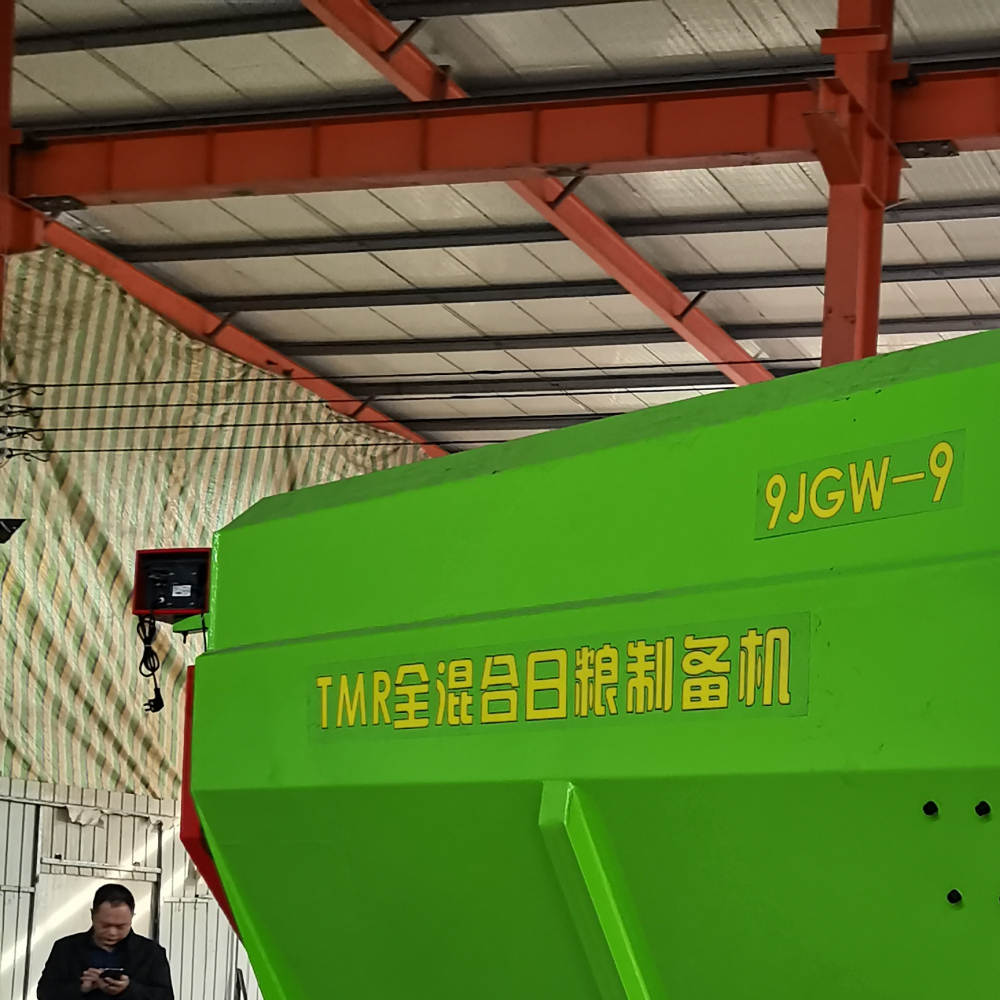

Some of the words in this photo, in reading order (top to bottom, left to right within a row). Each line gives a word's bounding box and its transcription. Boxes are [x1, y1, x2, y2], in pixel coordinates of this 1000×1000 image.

[765, 440, 954, 530] 9JGW-9
[316, 626, 792, 730] TMR全混合日粮制备机
